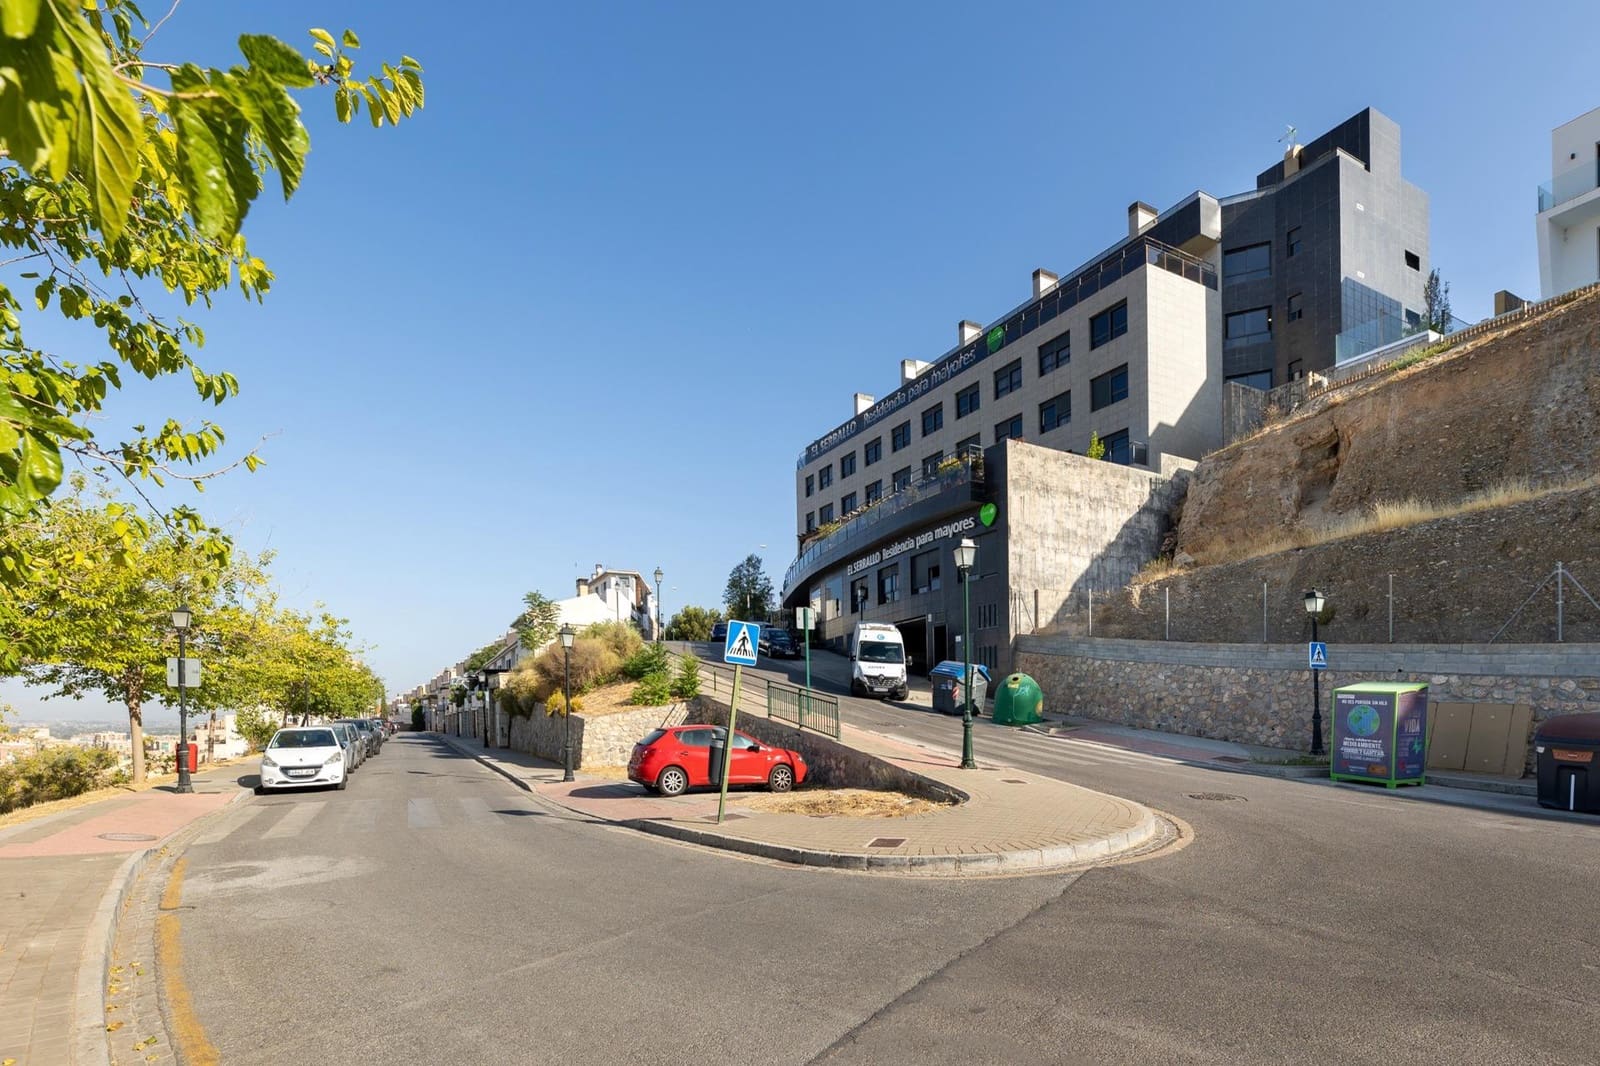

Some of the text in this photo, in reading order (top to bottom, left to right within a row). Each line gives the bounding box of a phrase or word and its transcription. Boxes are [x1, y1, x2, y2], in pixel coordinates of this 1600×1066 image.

[863, 392, 906, 425] Residencia
[908, 378, 929, 402] para
[931, 349, 977, 387] mayores
[853, 552, 881, 573] SERRALLO
[882, 537, 915, 560] Residencia
[916, 531, 934, 549] para
[934, 517, 975, 538] mayores
